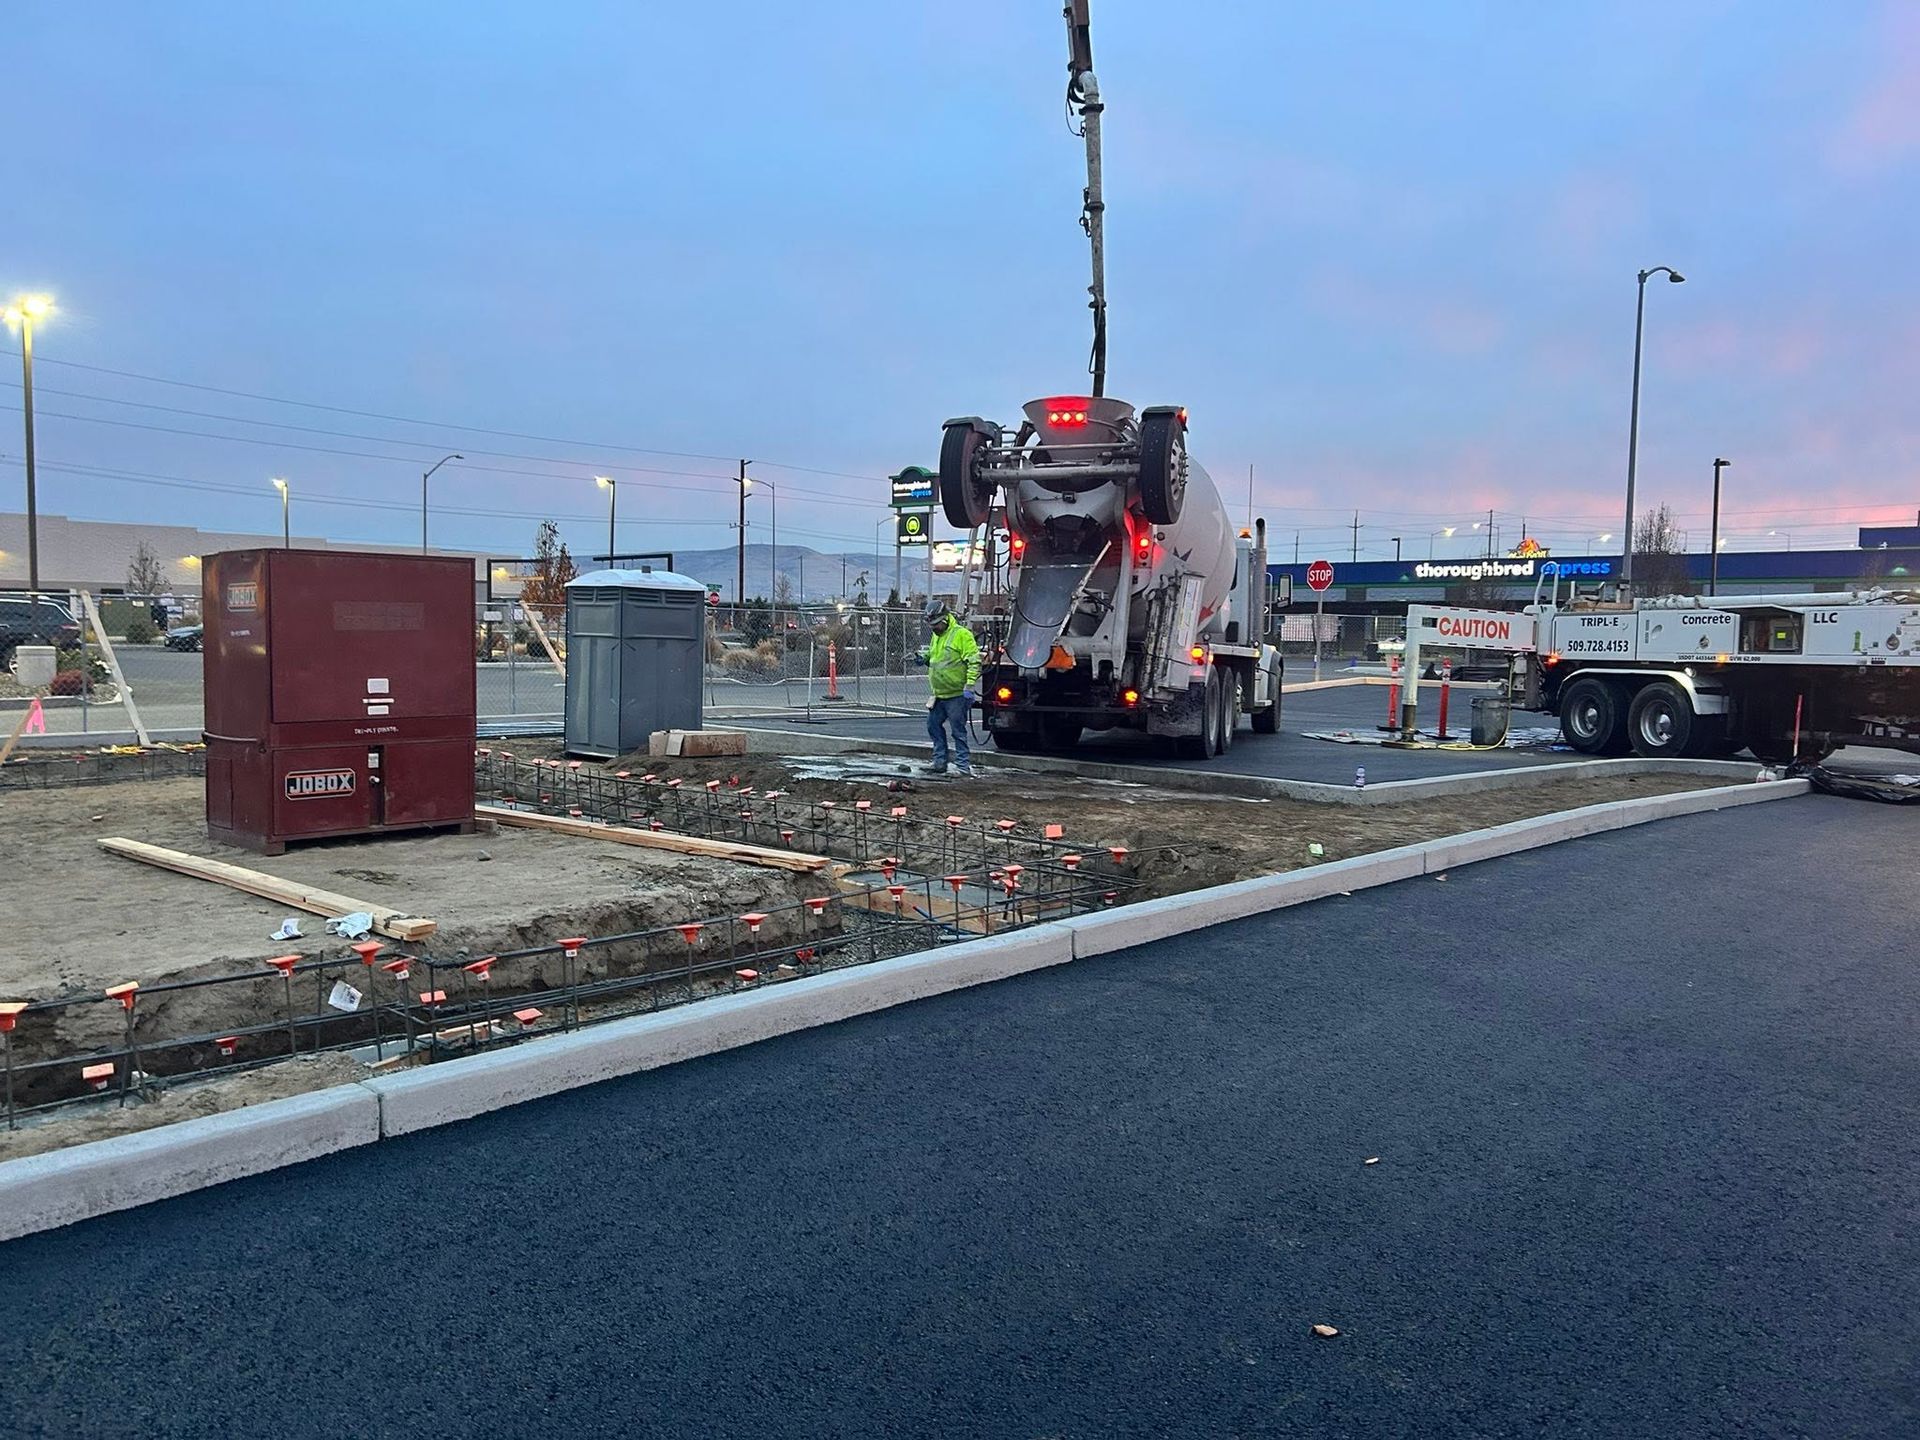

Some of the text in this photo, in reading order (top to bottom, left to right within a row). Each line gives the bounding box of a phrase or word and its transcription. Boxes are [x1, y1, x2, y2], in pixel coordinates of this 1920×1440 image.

[1309, 569, 1332, 582] STOP
[1415, 560, 1535, 580] thoroughbred
[1580, 617, 1619, 627] TRIPL-E
[1681, 614, 1732, 625] Concrete
[1813, 612, 1838, 624] LLC
[1438, 616, 1510, 640] CAUTION
[1567, 639, 1629, 653] 509.728.4153
[289, 774, 352, 794] JOBOX
